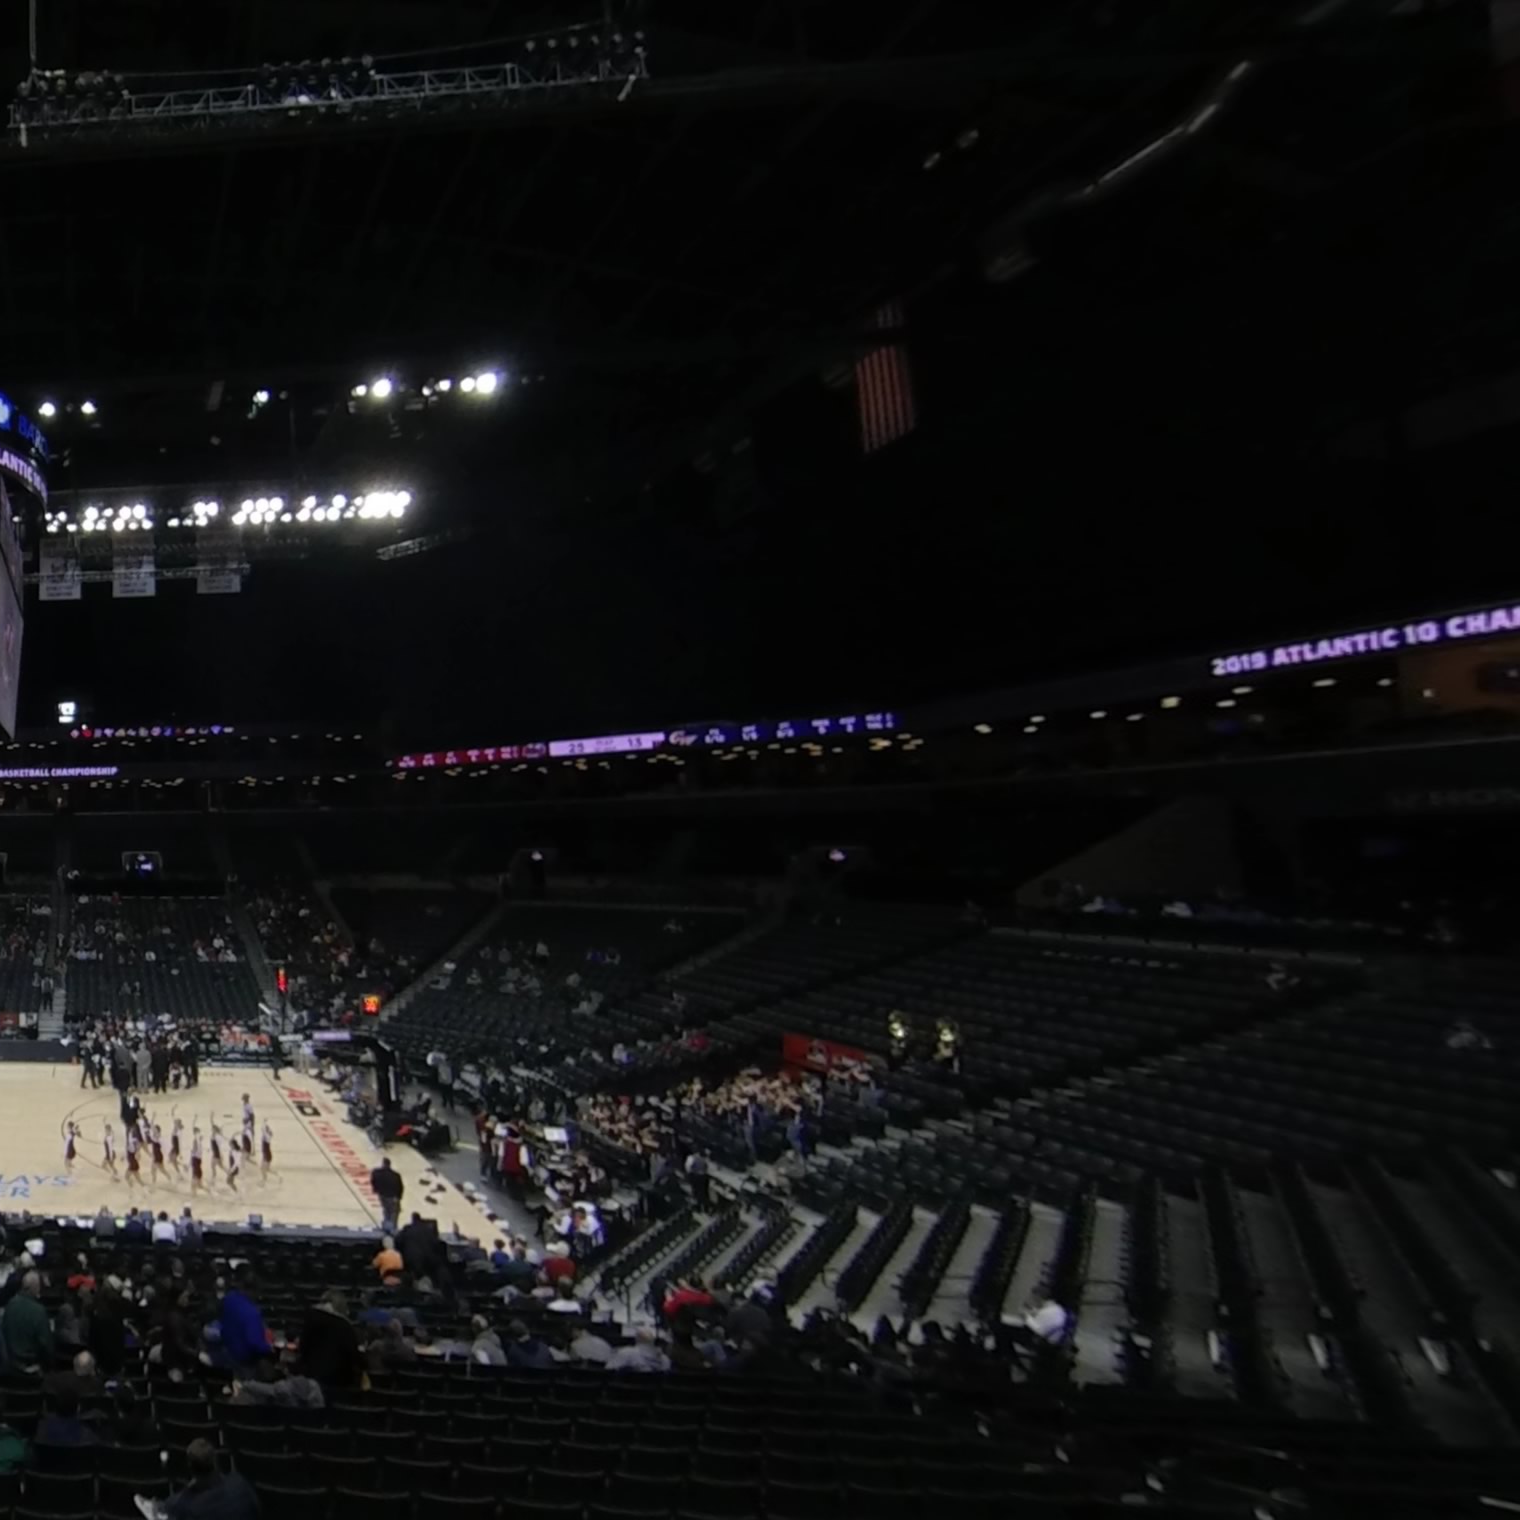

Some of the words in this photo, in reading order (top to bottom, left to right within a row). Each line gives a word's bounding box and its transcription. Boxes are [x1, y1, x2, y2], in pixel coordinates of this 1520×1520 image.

[1211, 651, 1267, 676] 2019
[1273, 629, 1399, 667] ATLANTIC
[1403, 620, 1440, 645] 10
[51, 766, 118, 777] CHAMPIONSHIP
